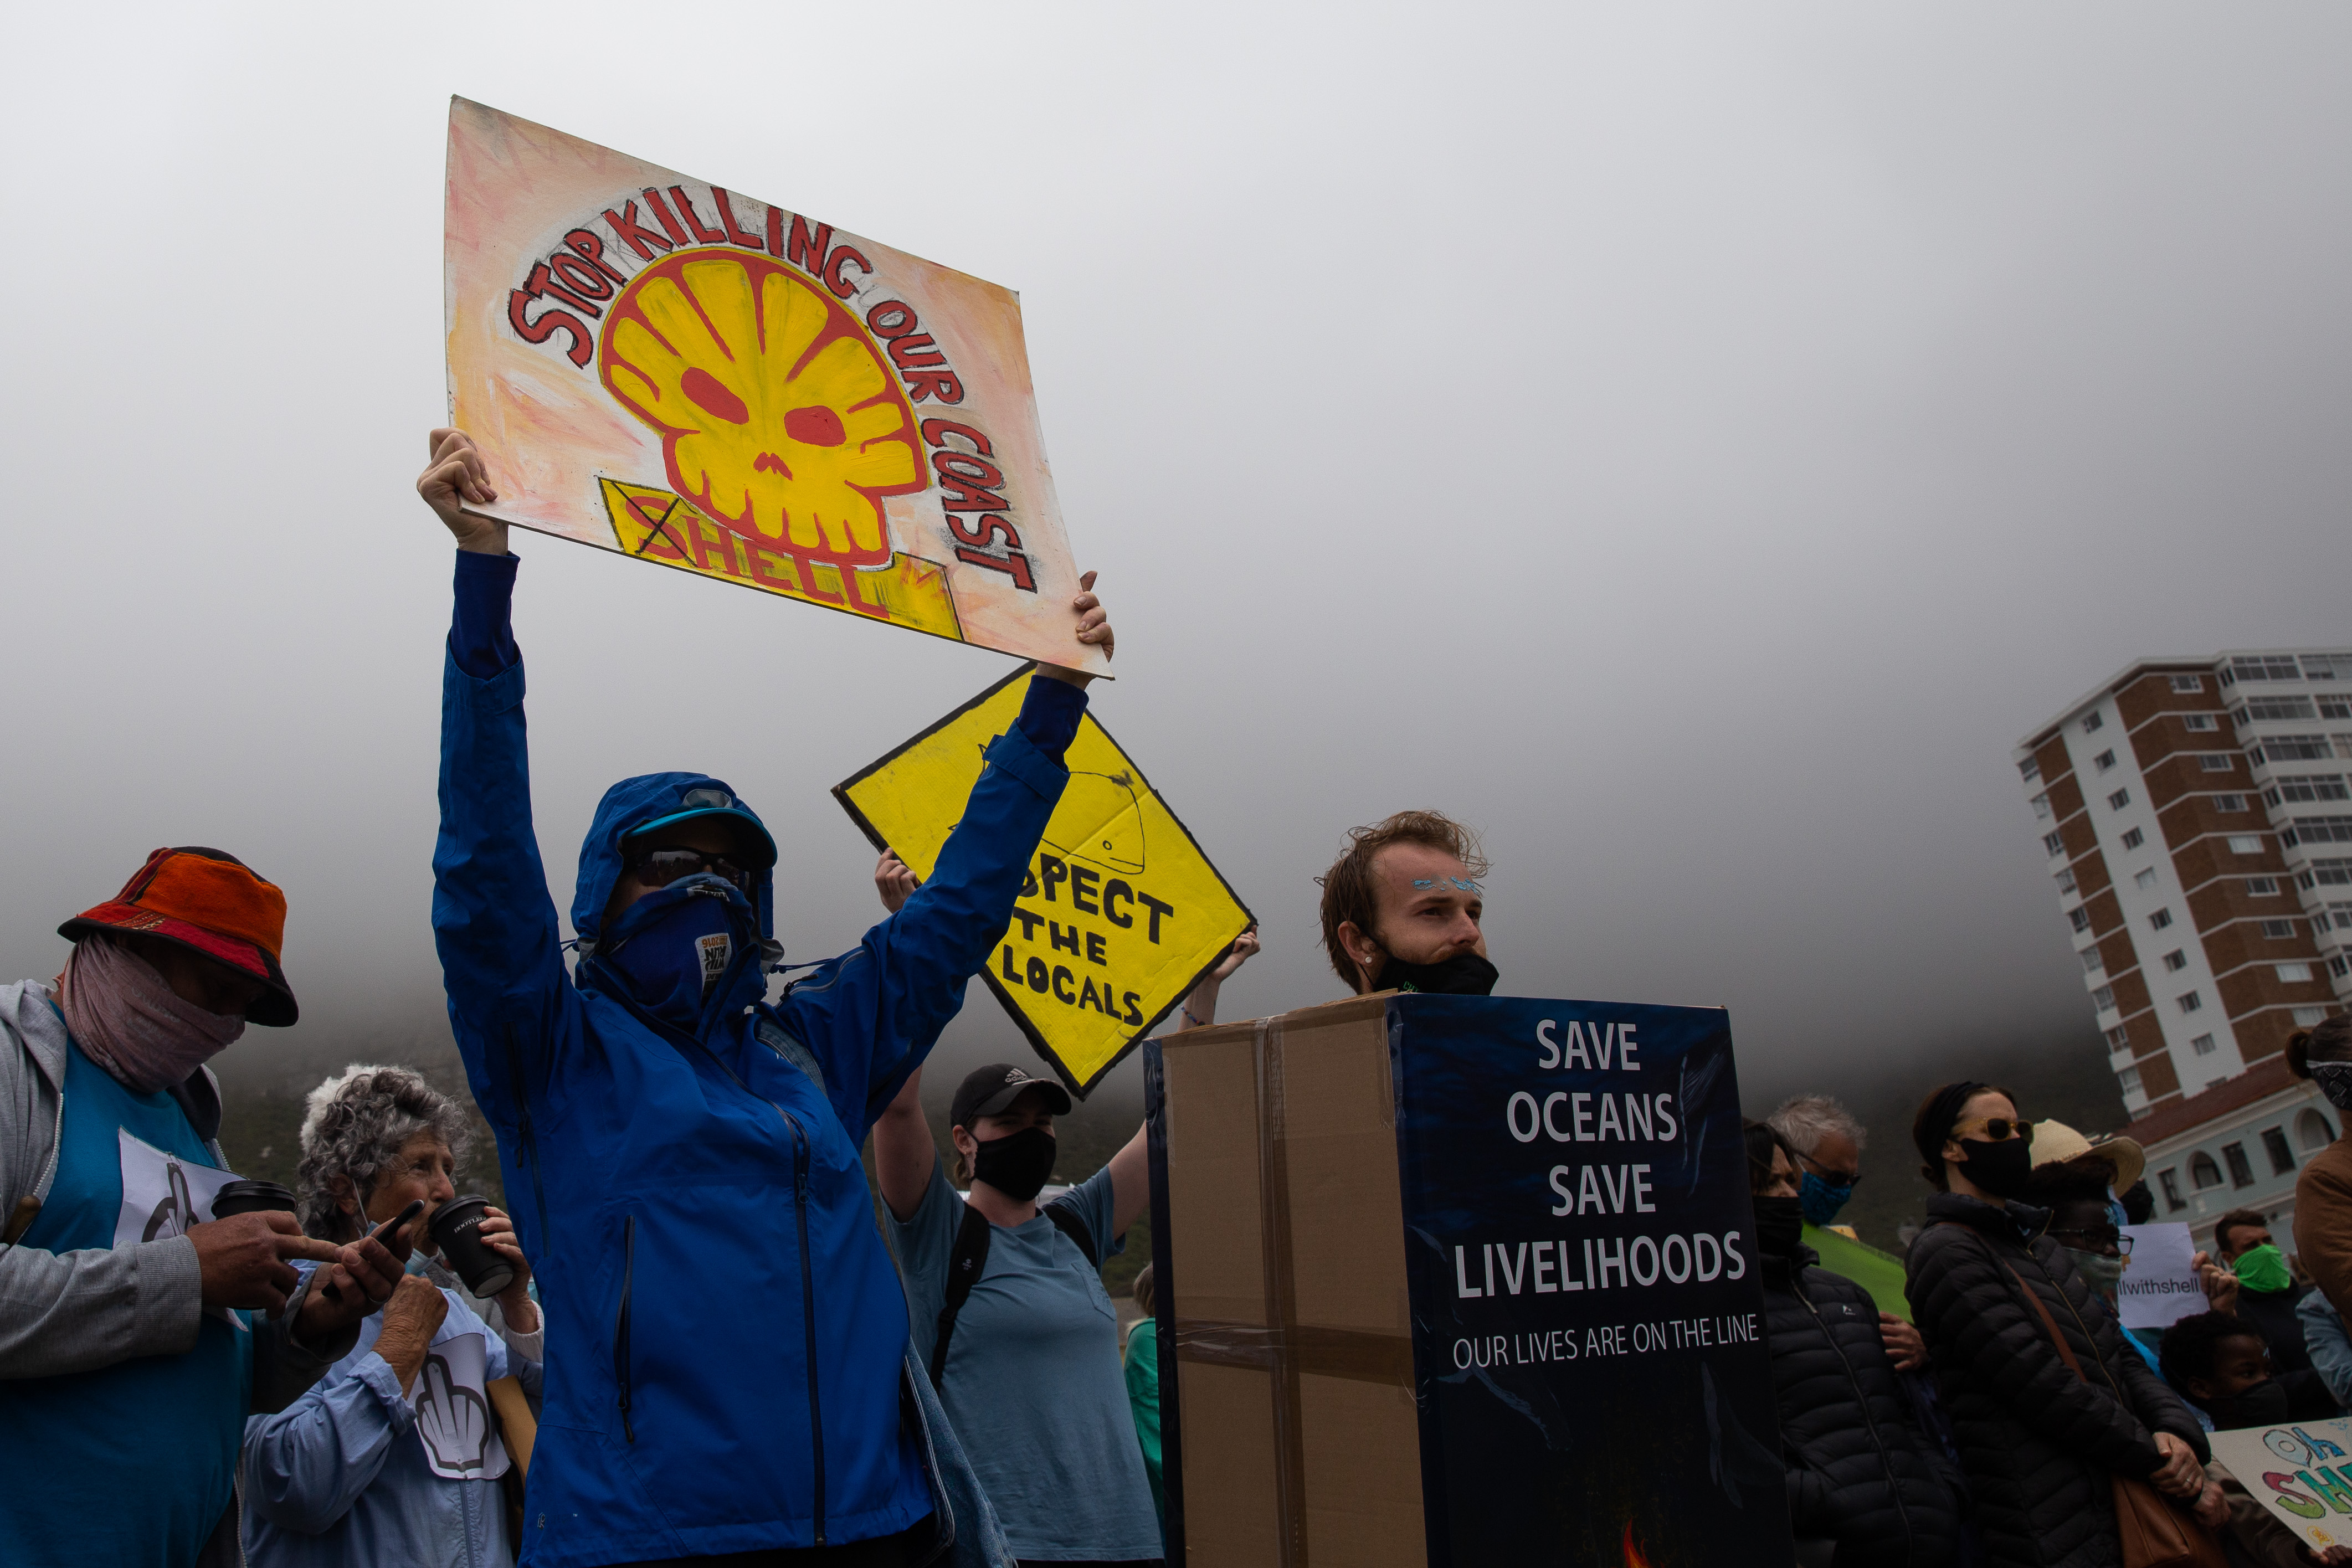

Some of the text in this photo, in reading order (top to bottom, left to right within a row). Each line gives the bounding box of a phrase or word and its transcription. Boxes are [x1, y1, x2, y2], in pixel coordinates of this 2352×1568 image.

[507, 185, 1038, 593] STOP KILLING OUR COAST
[625, 495, 890, 620] SHELL
[701, 937, 719, 948] 2016
[1013, 905, 1107, 966] THE
[1002, 943, 1144, 1027] LOCALS
[1536, 1019, 1641, 1071] SAVE
[1507, 1091, 1677, 1143] OCEANS
[1549, 1164, 1656, 1216] SAVE
[1455, 1231, 1746, 1298] LIVELIHOODS
[1453, 1313, 1759, 1369] OUR LIVES ARE ON THE LINE
[2262, 1462, 2352, 1519] SH
